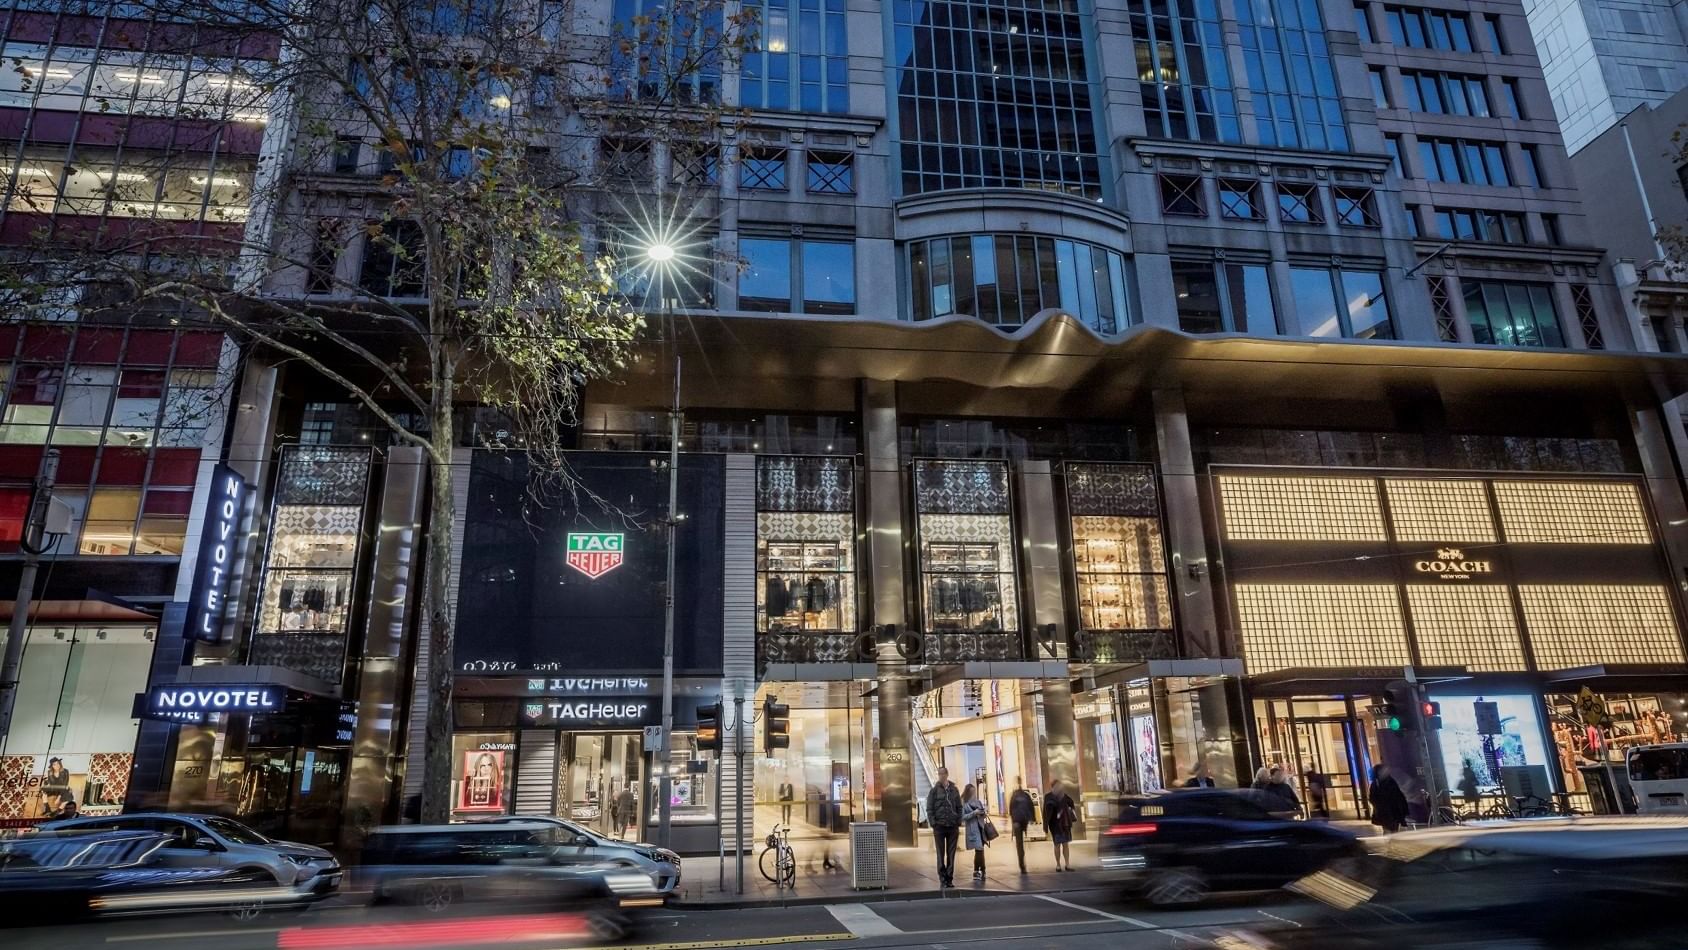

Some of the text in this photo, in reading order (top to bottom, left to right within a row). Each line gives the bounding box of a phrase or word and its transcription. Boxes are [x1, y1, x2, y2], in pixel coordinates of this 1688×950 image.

[572, 535, 619, 550] TAG
[203, 477, 239, 633] NOVOTEL
[570, 553, 620, 575] HEUER
[1415, 561, 1491, 572] COACH
[158, 691, 273, 707] NOVOTEL
[887, 753, 903, 761] 260
[184, 766, 203, 775] 270
